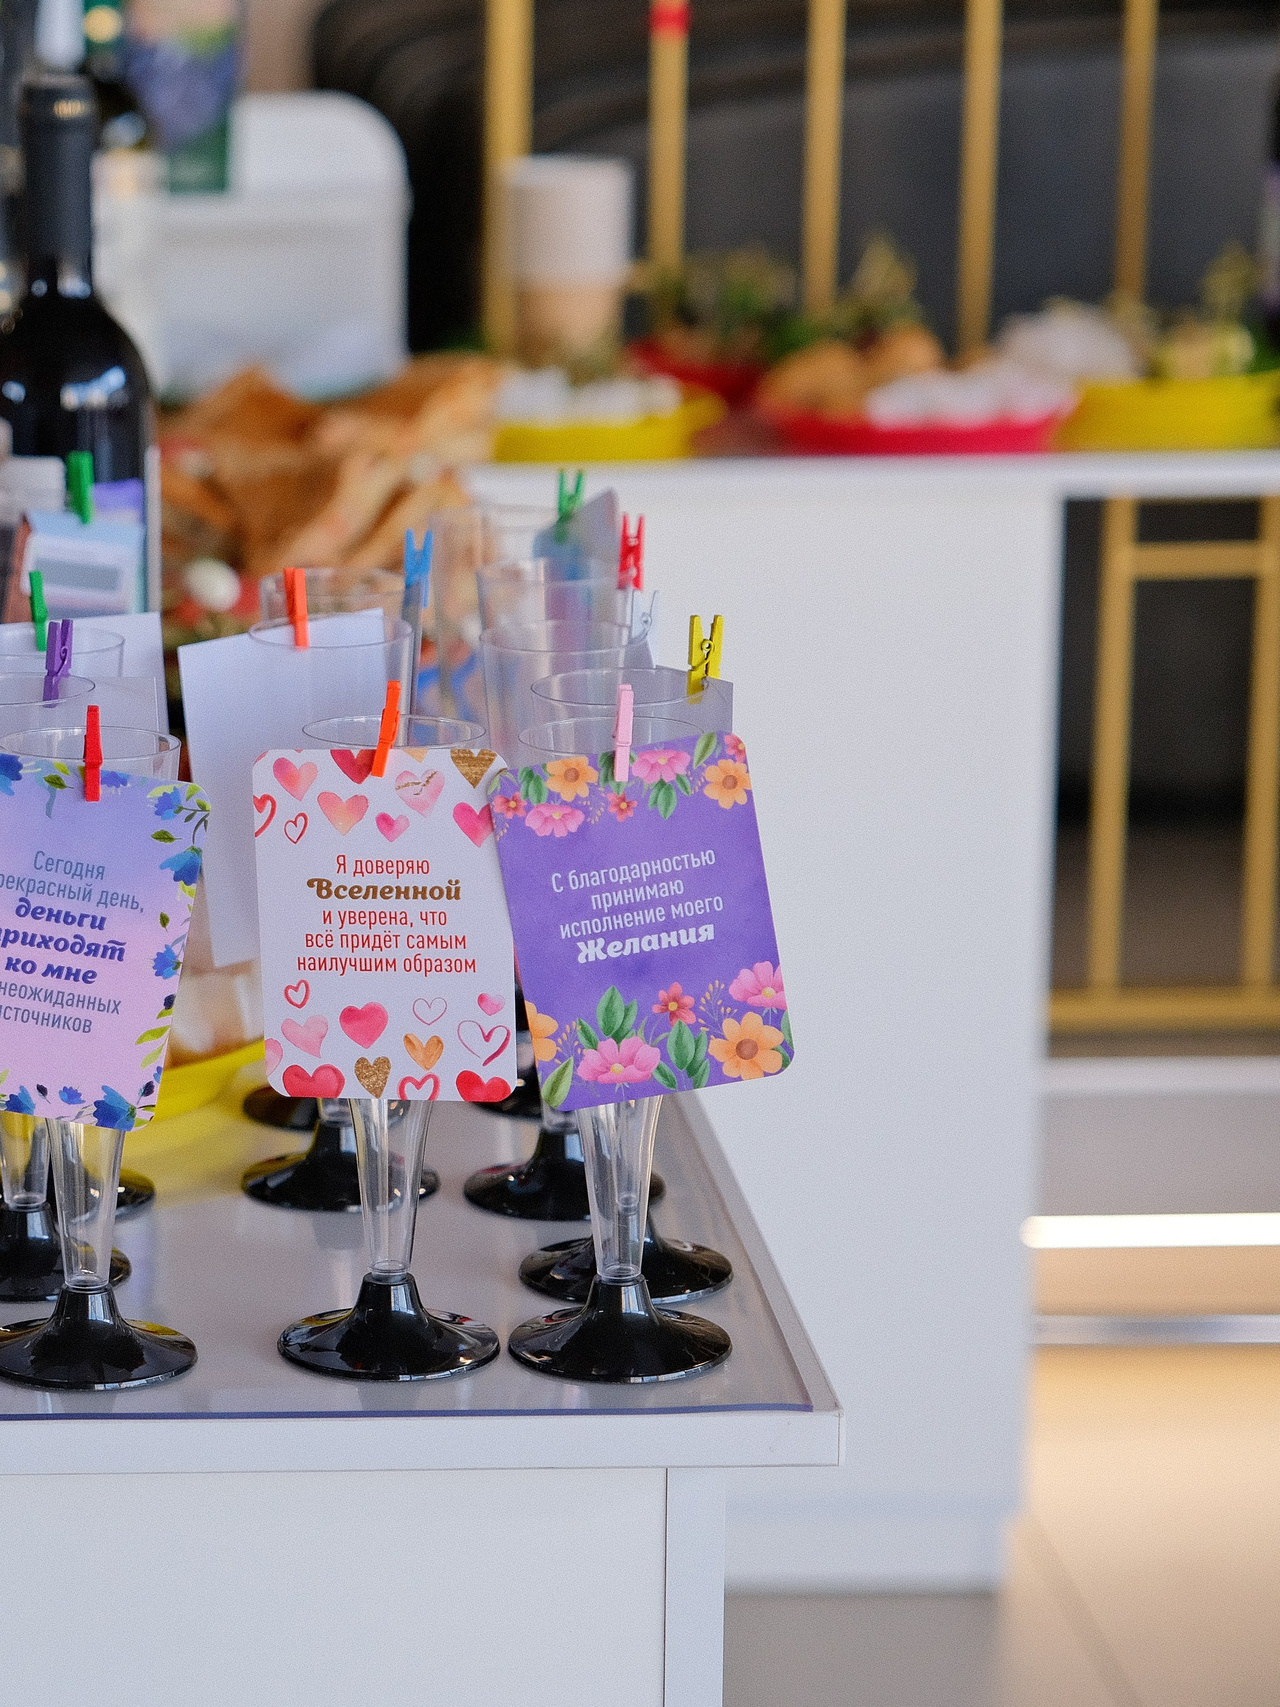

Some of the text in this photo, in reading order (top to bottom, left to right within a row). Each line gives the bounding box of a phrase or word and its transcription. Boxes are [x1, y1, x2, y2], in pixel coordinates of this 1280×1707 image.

[33, 850, 106, 880] Сегодня
[336, 854, 430, 879] Я доверяю
[551, 849, 716, 893] С благодарностью
[96, 889, 144, 913] день,
[306, 877, 462, 901] Вселенной
[591, 879, 685, 912] принимаю
[15, 896, 107, 931] деньги
[322, 909, 448, 930] и уверена, что
[559, 896, 724, 939] исполнение моего
[305, 929, 467, 953] всё придёт самым
[576, 923, 716, 964] Желания
[4, 956, 98, 985] ко мне
[297, 952, 477, 978] наилучшим образом
